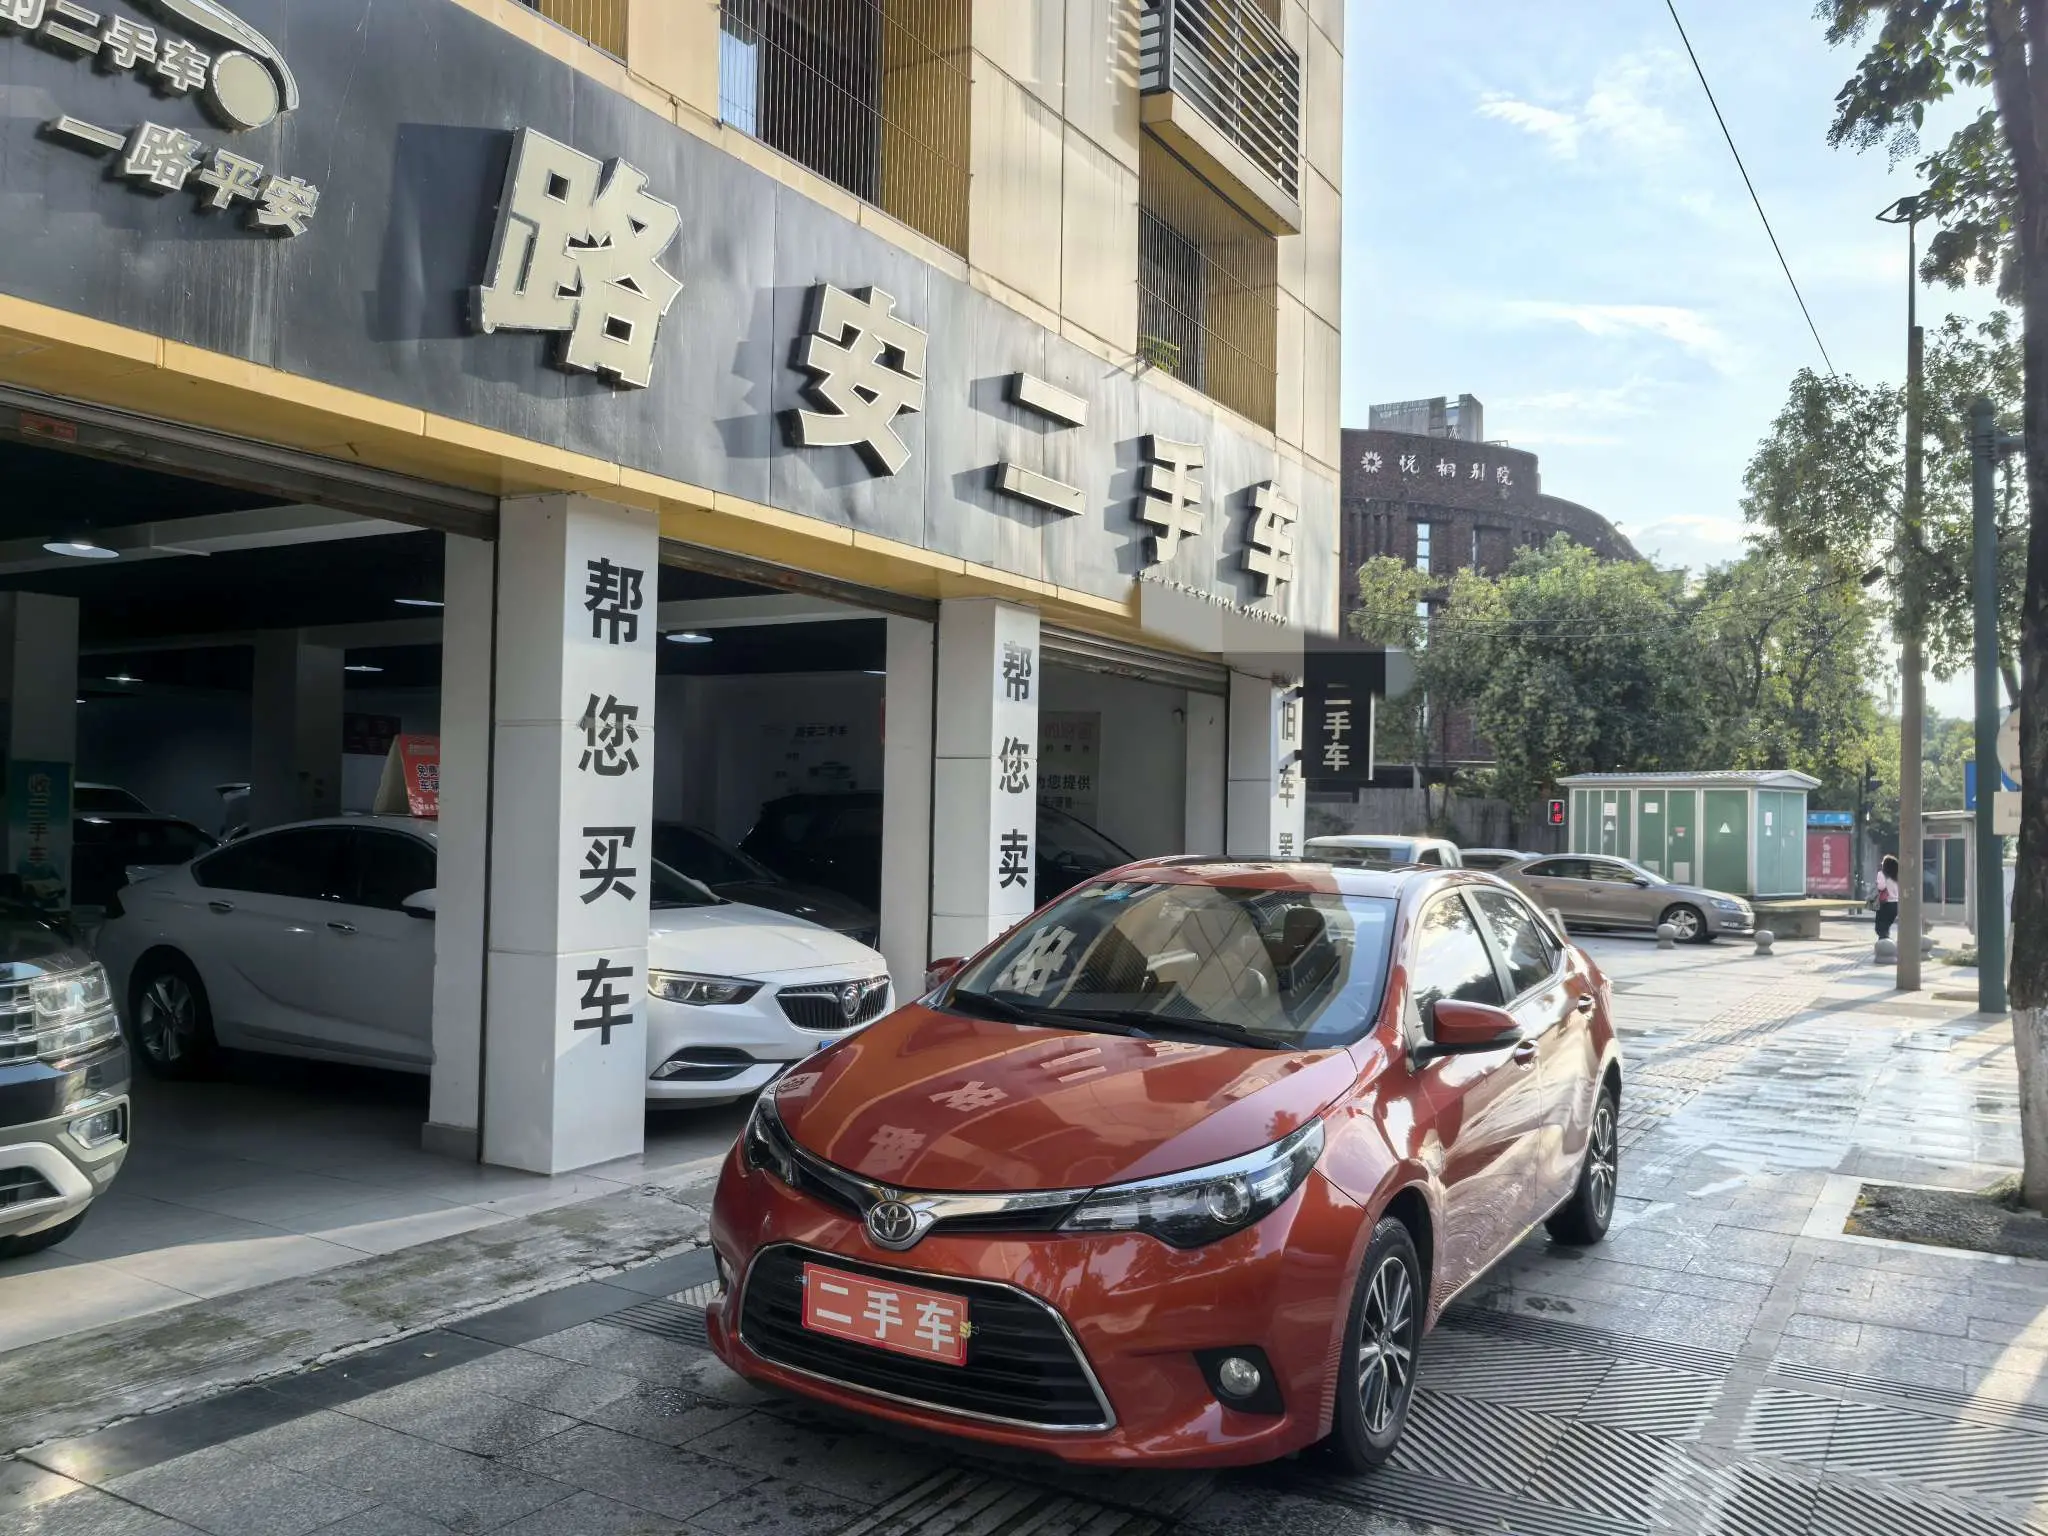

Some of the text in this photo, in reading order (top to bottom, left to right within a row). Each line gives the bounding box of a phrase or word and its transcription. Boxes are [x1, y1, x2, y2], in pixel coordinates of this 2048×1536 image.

[57, 114, 320, 237] 一路平安
[479, 126, 1300, 598] 路安二手车
[573, 557, 645, 1046] 帮您买车
[998, 640, 1032, 930] 帮您卖
[1322, 682, 1352, 772] 二手车
[816, 1281, 956, 1352] 二手车
